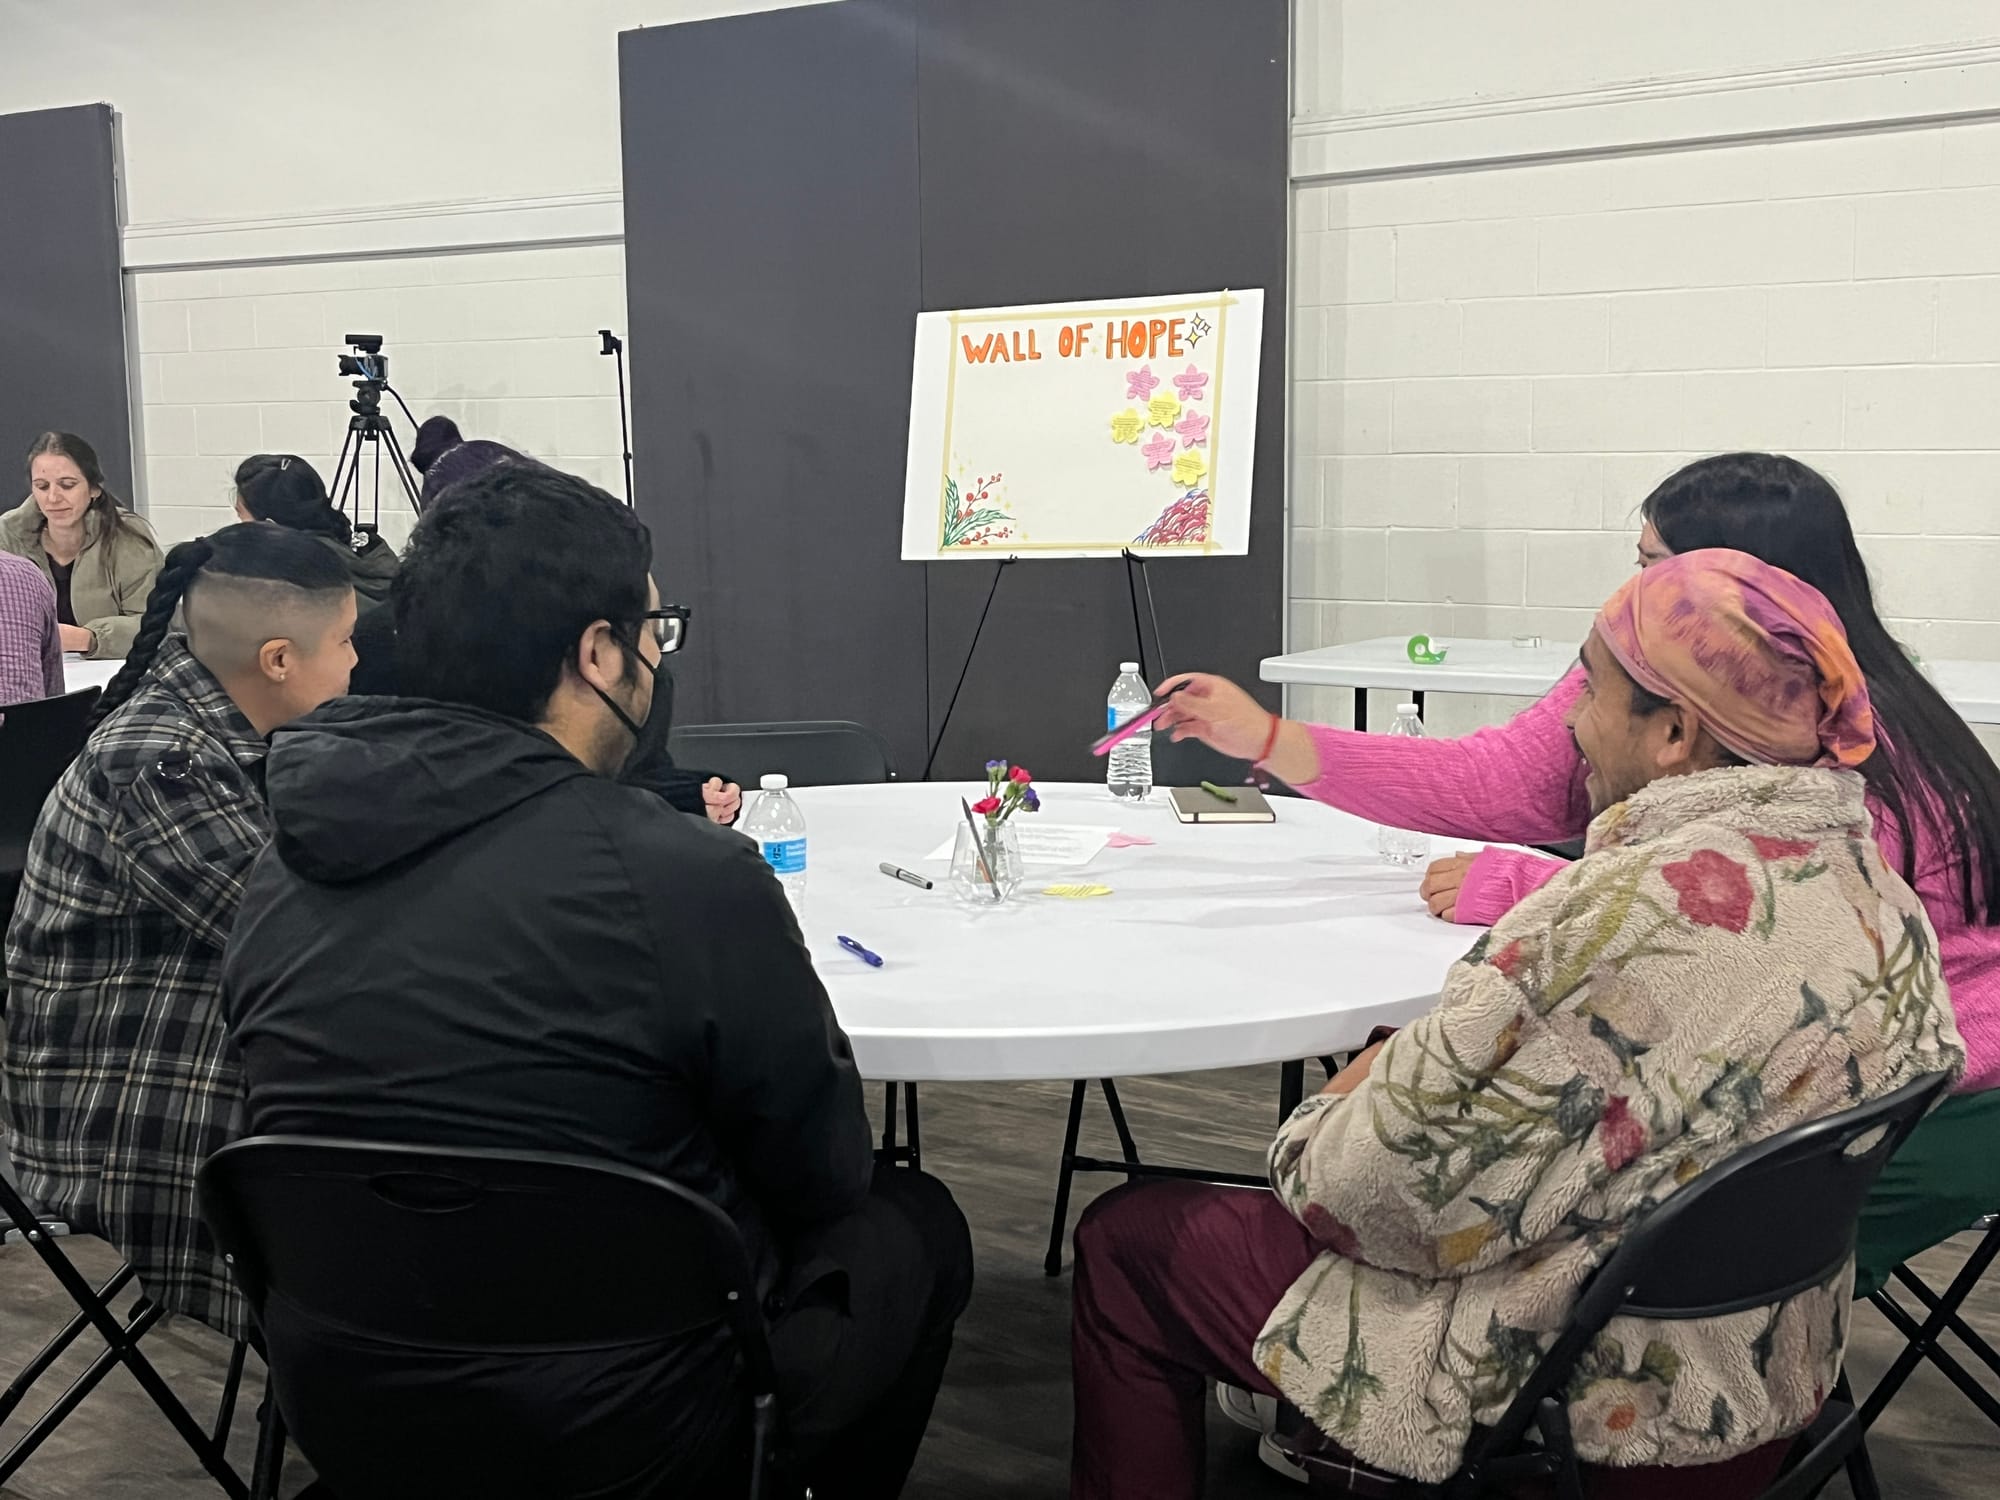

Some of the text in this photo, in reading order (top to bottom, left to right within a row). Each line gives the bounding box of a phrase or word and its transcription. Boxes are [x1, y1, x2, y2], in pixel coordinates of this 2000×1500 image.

[961, 318, 1186, 364] WALL OF HOPE
